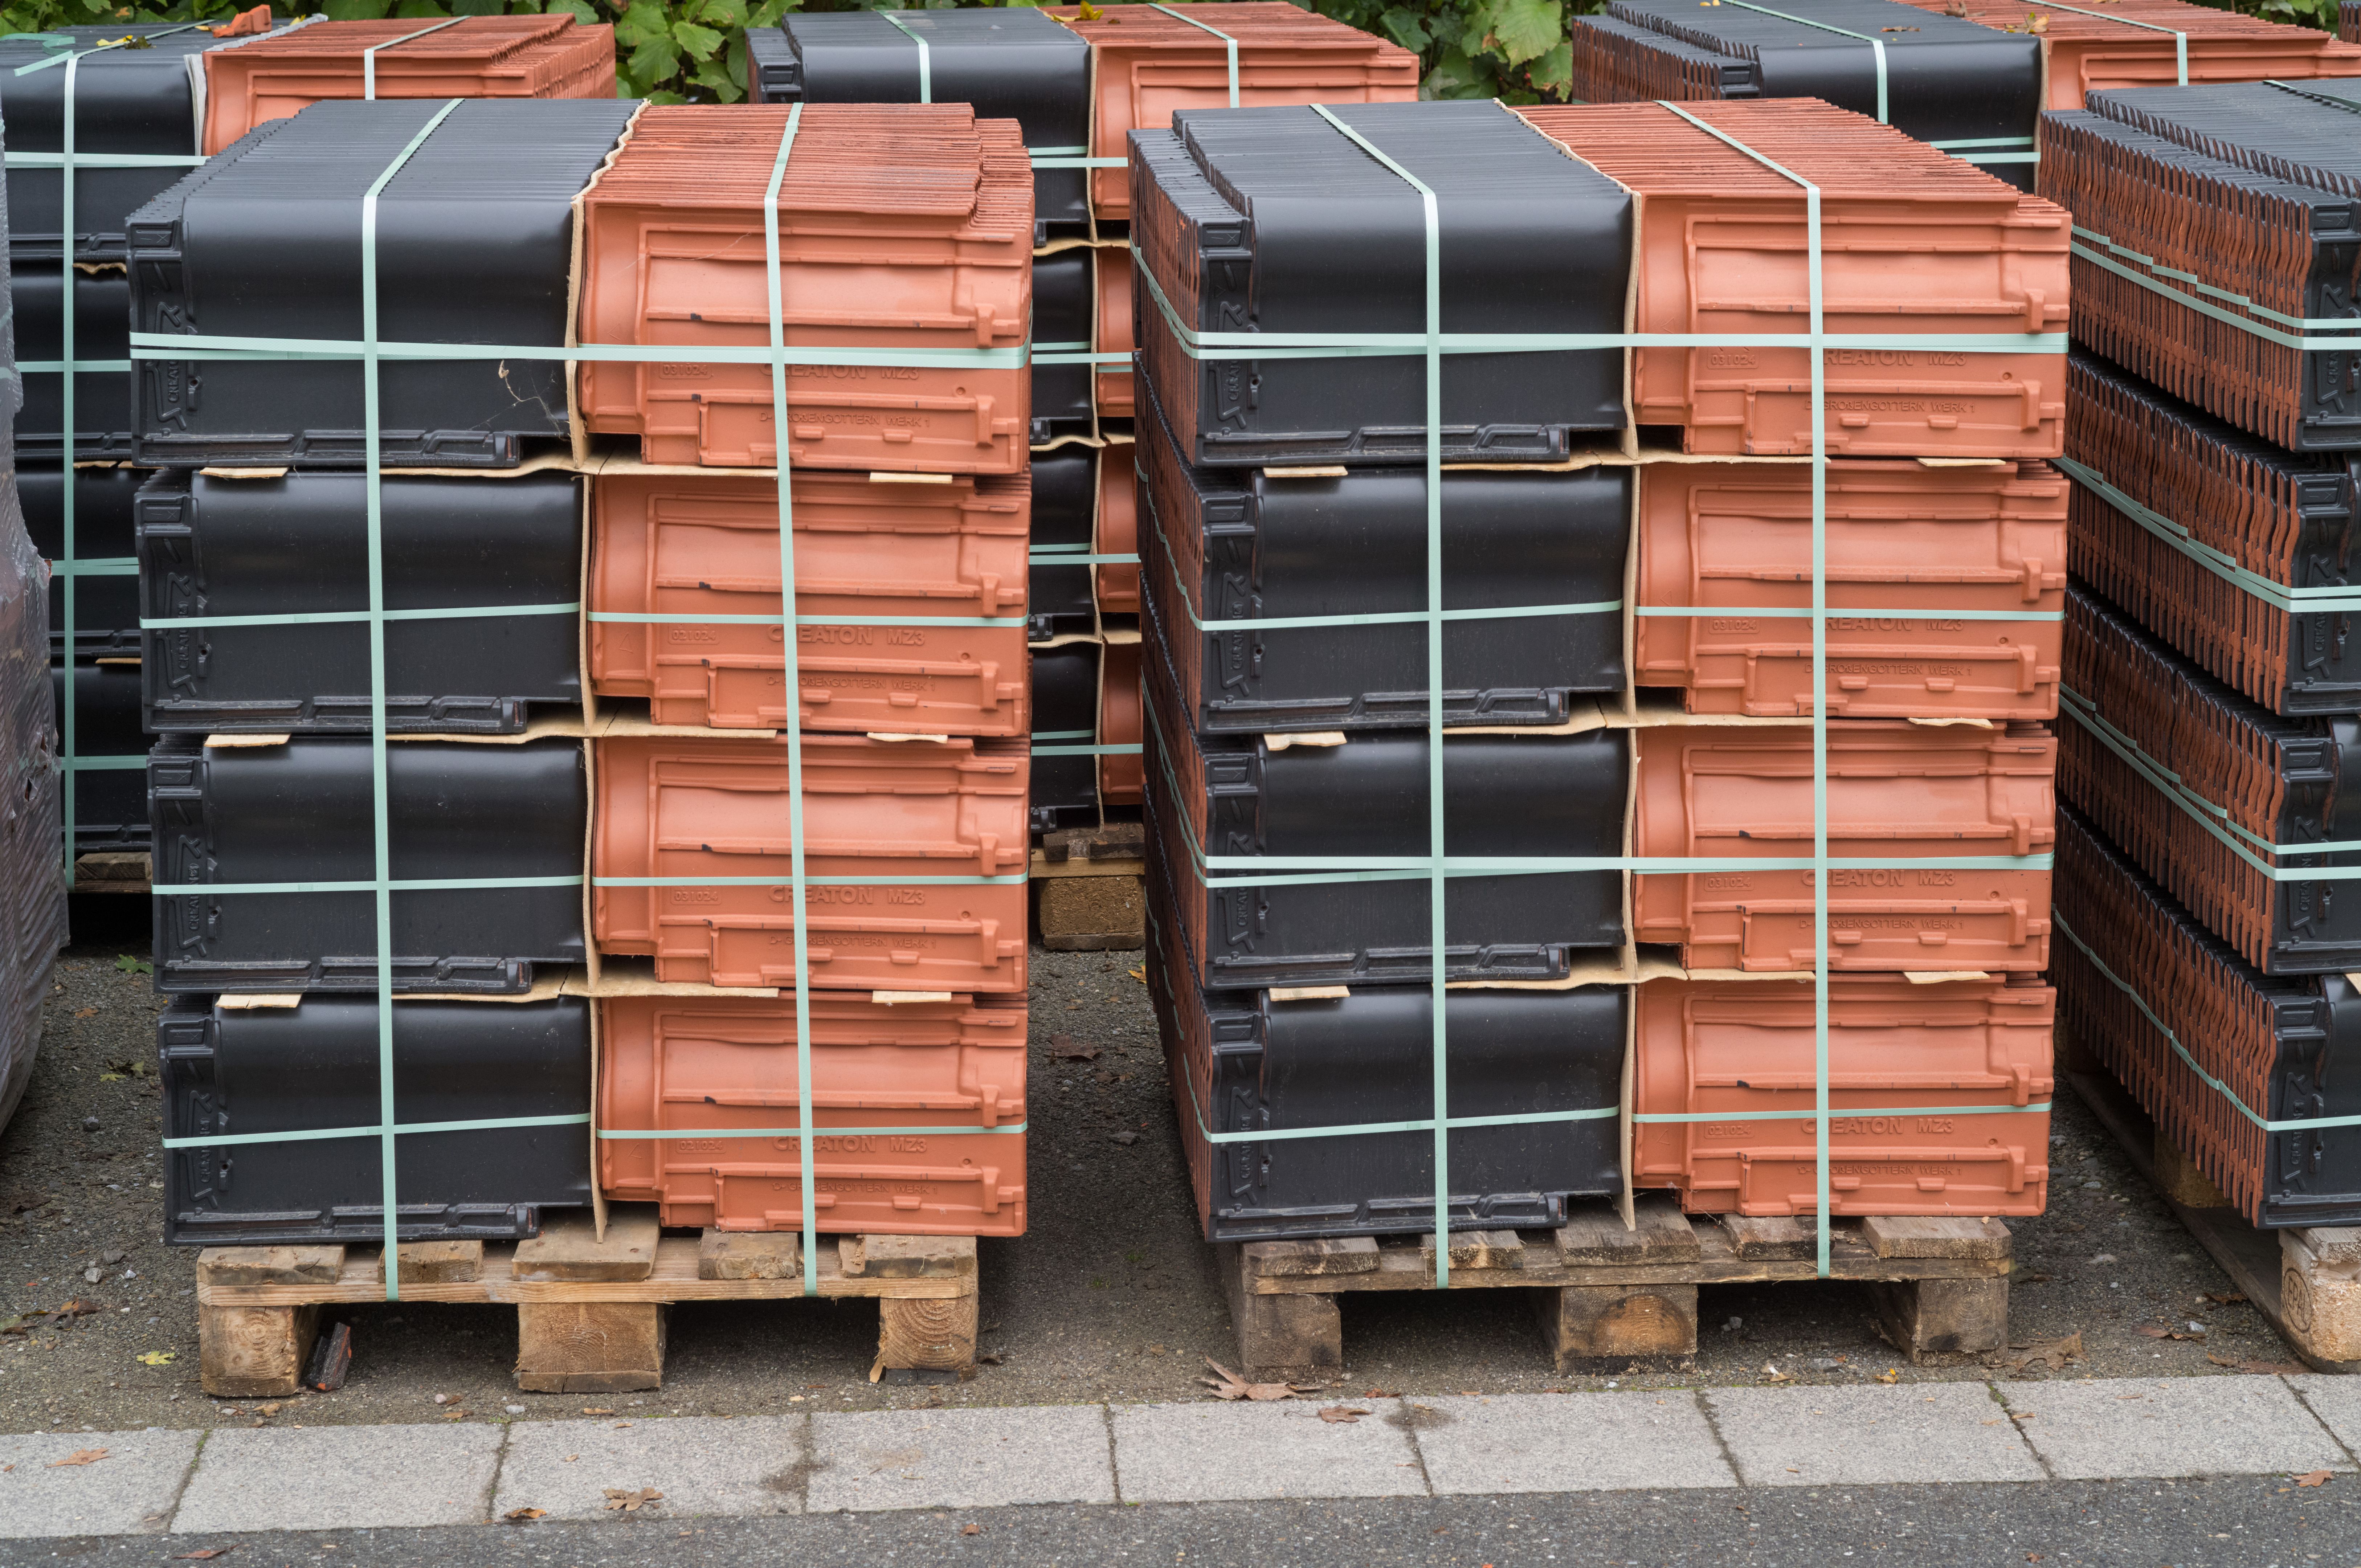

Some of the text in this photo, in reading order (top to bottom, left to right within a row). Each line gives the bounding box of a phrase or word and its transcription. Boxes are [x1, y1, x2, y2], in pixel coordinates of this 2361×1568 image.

[1809, 348, 1966, 365] REATON MZ3
[881, 367, 919, 380] MZ3
[1932, 401, 1966, 412] WERK
[886, 417, 921, 427] WERK
[1927, 619, 1964, 631] MZ3
[767, 624, 925, 645] CEATON MZ3
[1929, 665, 1962, 675] WERK
[892, 679, 926, 690] WERK
[1919, 870, 1955, 885] MZ3
[888, 888, 925, 904] MZ3
[1921, 920, 1955, 929] WERK
[893, 938, 927, 948] WERK
[1801, 1118, 1954, 1134] CEATON MZ3
[773, 1135, 927, 1153] CRATON MZ3
[1920, 1166, 1953, 1175] WERK
[895, 1184, 930, 1194] WERK
[2288, 1275, 2307, 1327] EPAL
